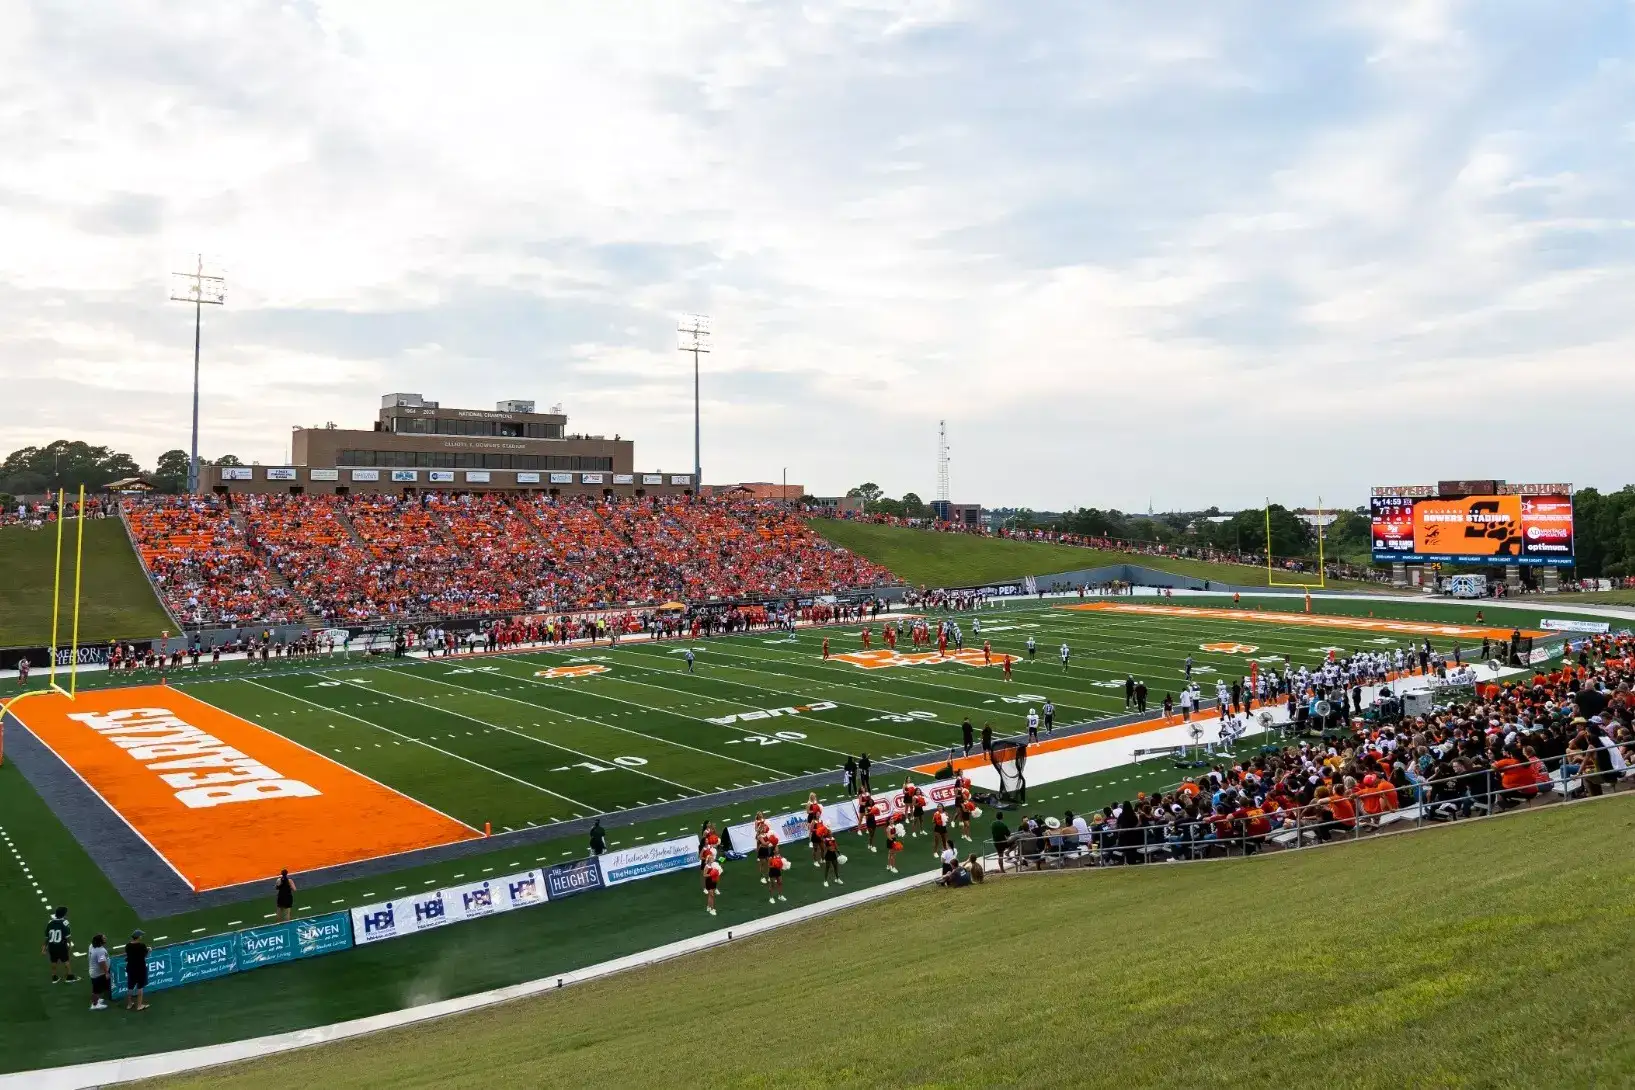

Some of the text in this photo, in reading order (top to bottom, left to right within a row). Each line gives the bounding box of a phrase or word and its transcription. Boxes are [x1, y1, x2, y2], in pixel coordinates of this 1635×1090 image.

[1528, 543, 1568, 551] optimum.
[880, 711, 938, 722] 30
[744, 731, 807, 746] 20
[66, 708, 324, 808] BEARKATS
[572, 756, 648, 773] 10
[650, 846, 671, 860] Student
[552, 868, 562, 876] THE
[553, 870, 596, 891] HEIGHTS
[304, 924, 340, 939] HAVEN
[248, 935, 283, 950] HAVEN
[188, 947, 226, 964] HAVEN
